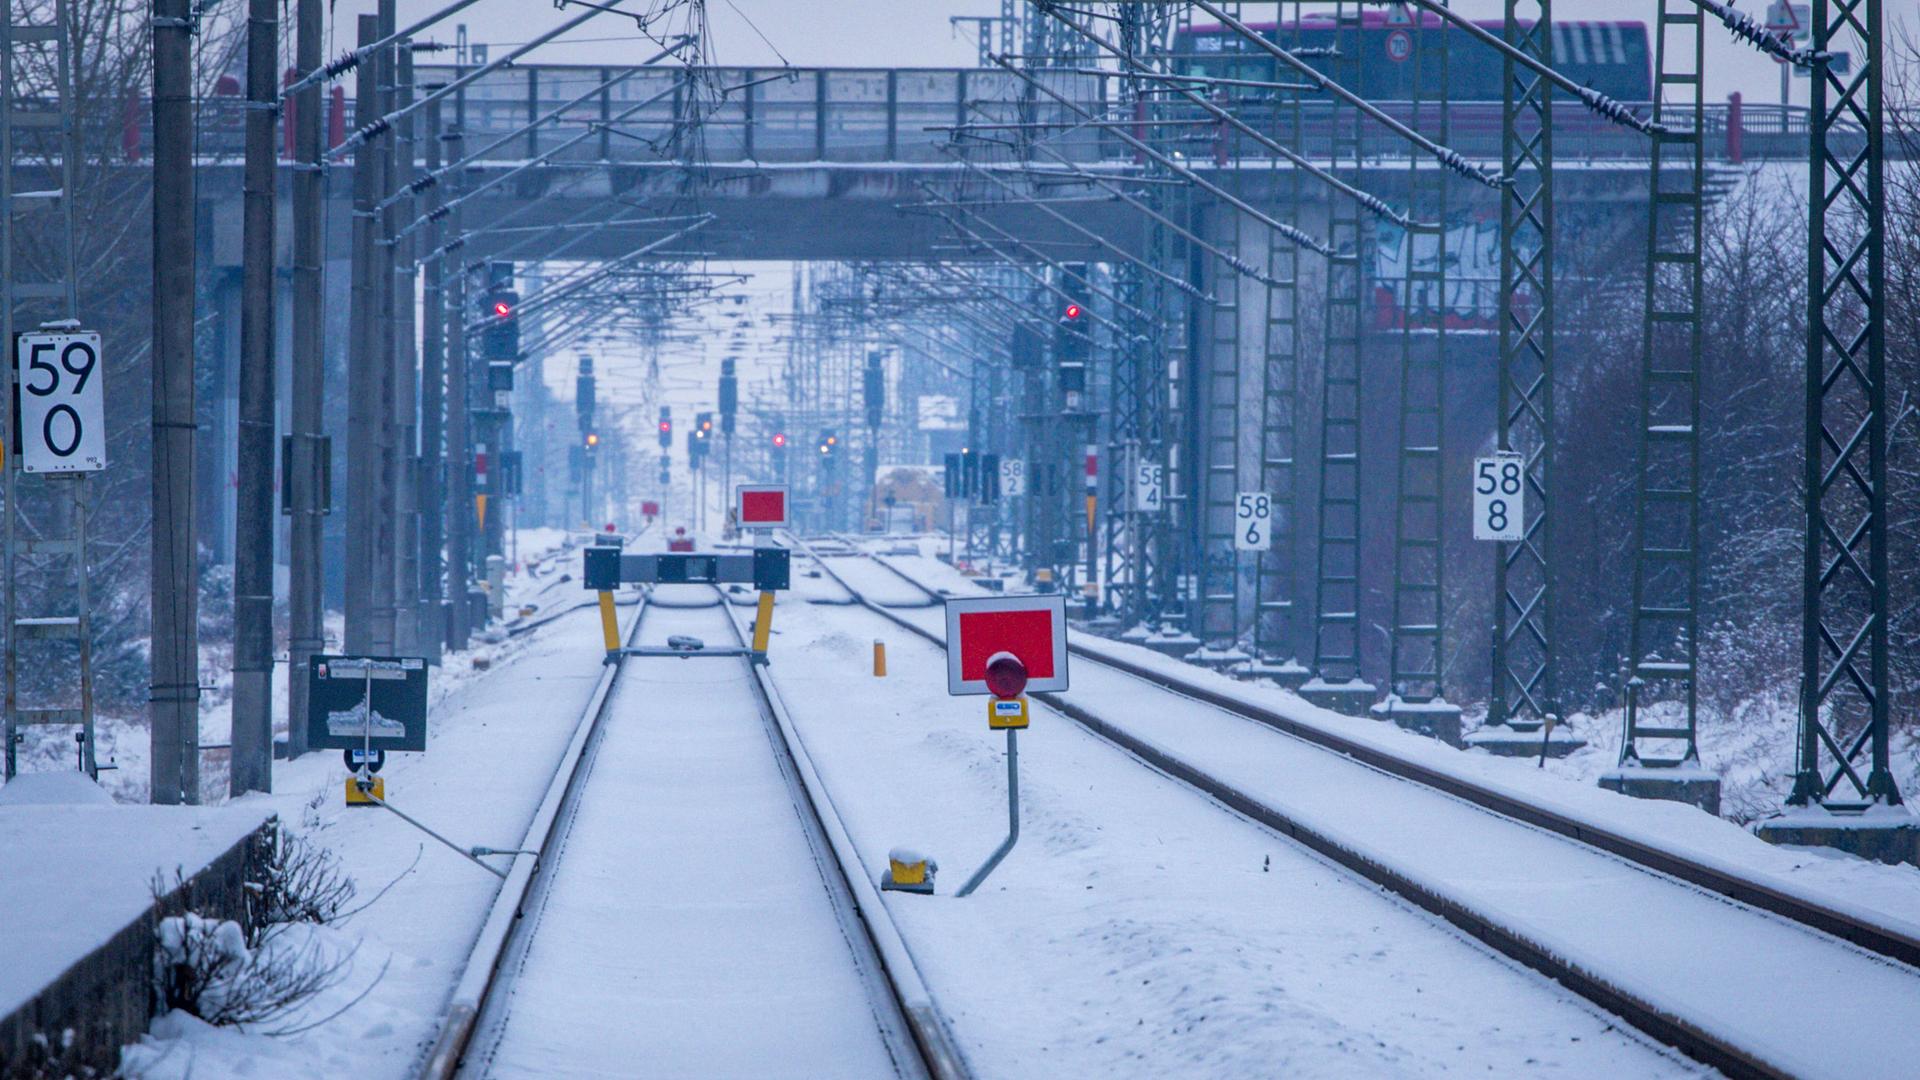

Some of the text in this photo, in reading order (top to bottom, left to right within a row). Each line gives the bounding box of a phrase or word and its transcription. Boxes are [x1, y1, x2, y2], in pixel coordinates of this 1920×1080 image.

[26, 342, 96, 397] 59
[43, 404, 82, 457] 0
[1003, 462, 1021, 477] 58
[1139, 467, 1163, 486] 58
[1476, 463, 1521, 495] 58
[1008, 478, 1017, 492] 2
[1146, 488, 1157, 506] 4
[1238, 495, 1269, 519] 58
[1488, 499, 1508, 532] 8
[1246, 522, 1260, 545] 6
